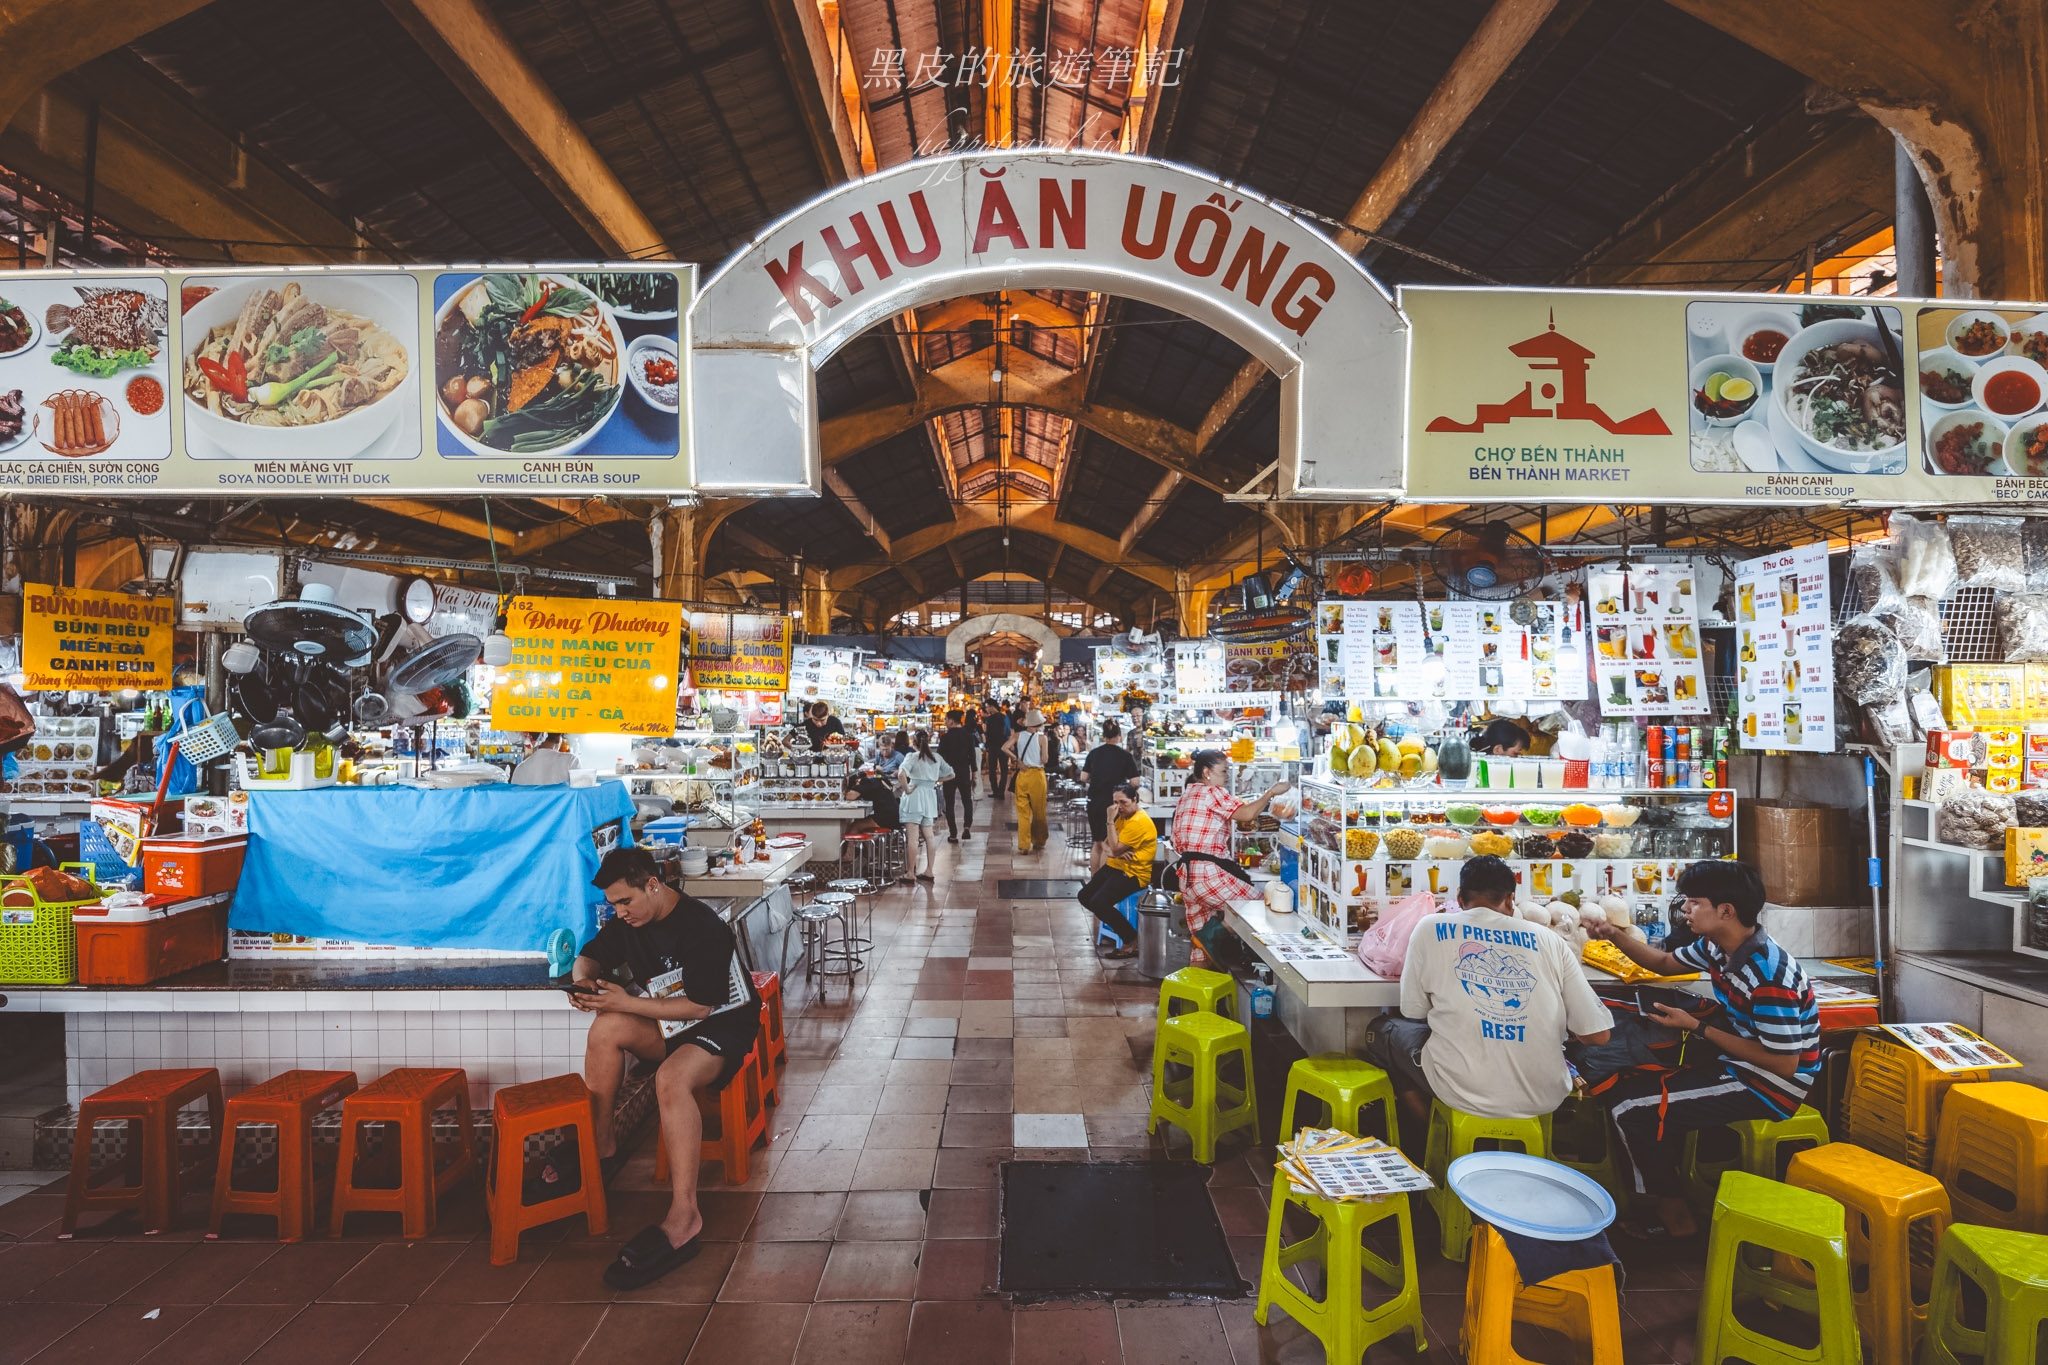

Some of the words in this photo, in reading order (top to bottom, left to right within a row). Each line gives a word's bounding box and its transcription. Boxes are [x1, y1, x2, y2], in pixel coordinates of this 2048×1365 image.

[764, 189, 942, 326] KHU
[972, 166, 1087, 255] ĂN
[1121, 183, 1337, 338] UỐNG
[1474, 447, 1517, 465] CHỢ
[1521, 445, 1558, 463] BẾN
[1563, 445, 1625, 463] THÀNH
[29, 462, 45, 474] CÁ
[48, 461, 86, 475] CHIÊN,
[89, 462, 123, 474] SƯỜN
[126, 463, 160, 476] CỌNG
[290, 461, 330, 473] MĂNG
[334, 463, 354, 476] VỊT
[523, 462, 561, 473] CANH
[565, 460, 594, 472] BÚN
[1469, 465, 1502, 481] BẾN
[1506, 465, 1561, 481] THÀNH
[1565, 468, 1631, 482] MARKET
[27, 475, 60, 484] DRIED
[63, 475, 90, 486] FISH,
[93, 475, 124, 485] PORK
[127, 474, 158, 484] CHOP
[218, 474, 253, 484] SOYA
[257, 474, 312, 484] NOODLE
[316, 474, 349, 484] WITH
[353, 474, 391, 484] DUCK
[477, 474, 557, 484] VERMICELLI
[561, 474, 599, 484] CRAB
[603, 473, 641, 484] SOUP
[1767, 474, 1799, 486] BÁNH
[1802, 476, 1833, 486] CANH
[1996, 477, 2026, 489] BÁNH
[1745, 487, 1771, 496] RICE
[1775, 487, 1821, 496] NOODLE
[1824, 487, 1855, 496] SOUP
[1763, 561, 1777, 571] Thu
[1779, 556, 1794, 567] Chè
[83, 598, 138, 621] MĂNG
[144, 605, 171, 626] VỊT
[54, 618, 97, 634] BÚN
[106, 622, 150, 637] RIÊU
[523, 611, 583, 634] Đông
[588, 611, 671, 638] Phương
[60, 636, 112, 653] MIẾN
[118, 640, 145, 655] GÀ
[513, 635, 555, 650] BÚN
[625, 641, 656, 655] VỊT
[1227, 645, 1253, 657] BÁNH
[1255, 646, 1273, 656] XÈO
[116, 658, 155, 673] BÚN
[511, 652, 553, 666] BÚN
[560, 654, 607, 669] RIÊU
[613, 657, 652, 671] CUA
[510, 669, 563, 684] CANH
[570, 669, 612, 685] BÚN
[567, 686, 593, 701] GÀ
[549, 706, 580, 720] VỊT
[599, 706, 625, 721] GÀ
[1435, 922, 1457, 943] MY
[1462, 924, 1539, 952] PRESENCE
[1461, 971, 1478, 982] WILL
[1482, 976, 1493, 984] GO
[1495, 979, 1515, 988] WITH
[1481, 1019, 1526, 1043] REST
